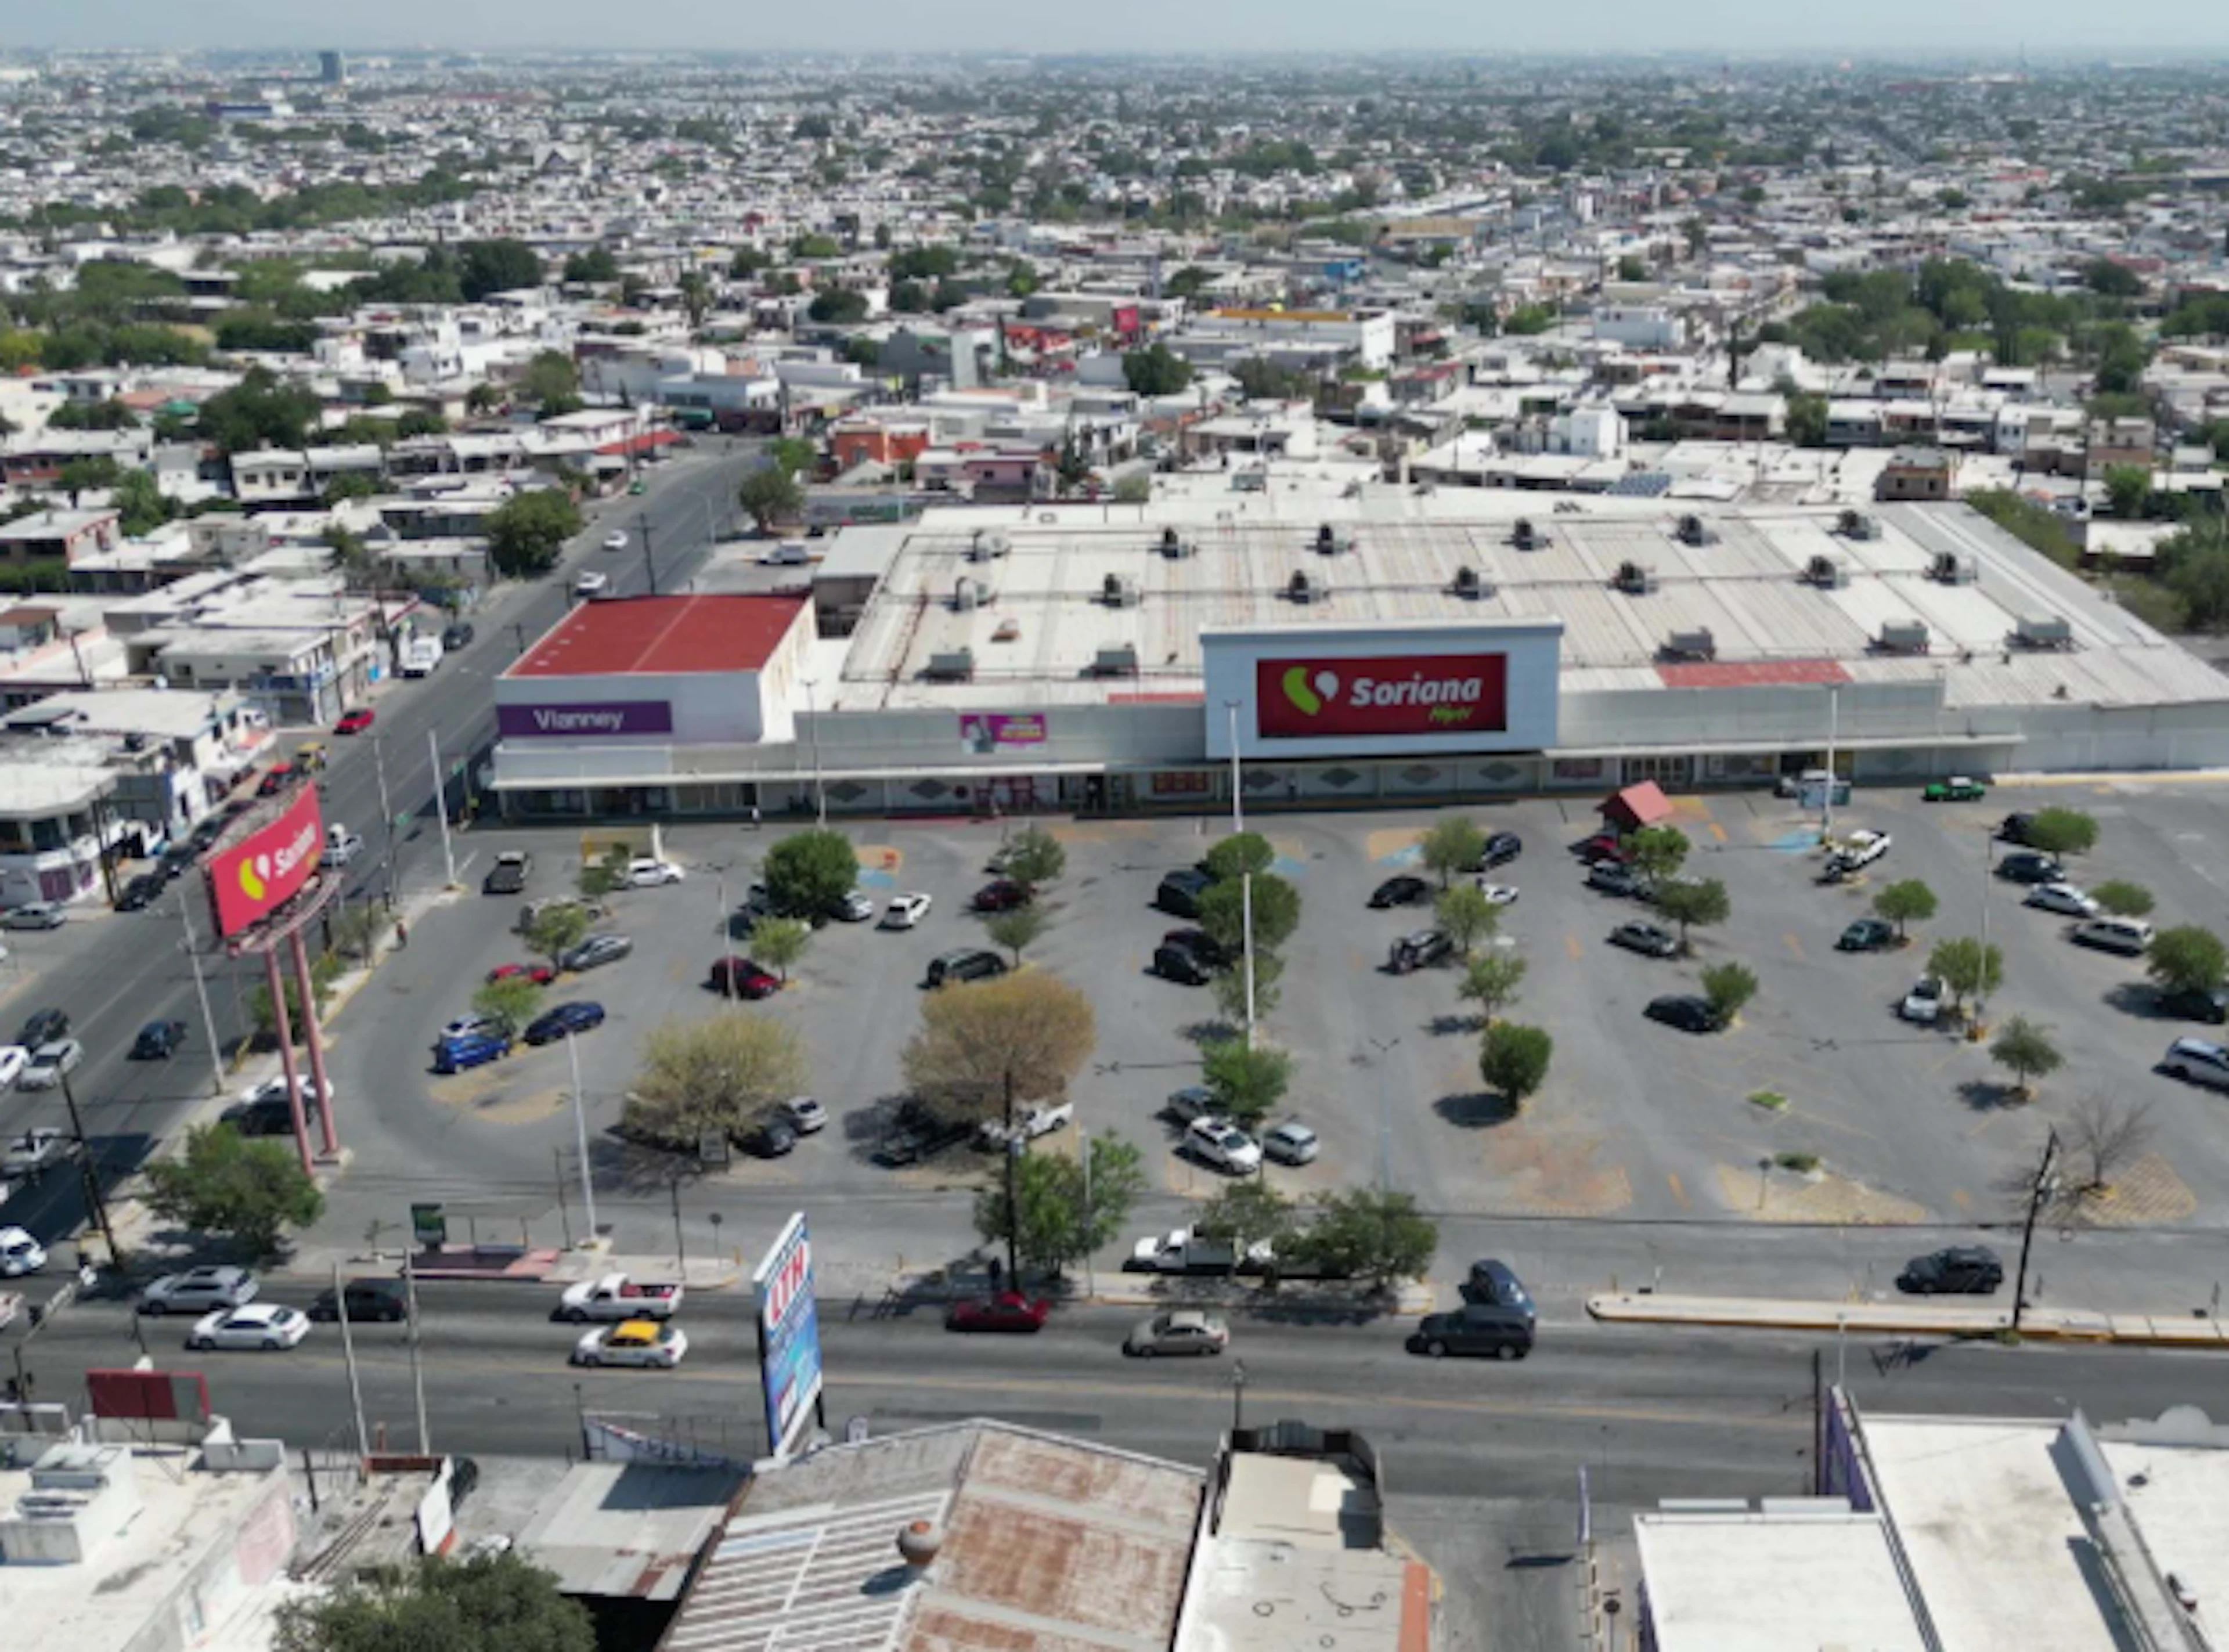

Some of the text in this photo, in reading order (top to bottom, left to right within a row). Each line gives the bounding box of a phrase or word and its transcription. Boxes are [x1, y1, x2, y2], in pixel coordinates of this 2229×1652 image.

[1350, 671, 1483, 706] Soriana
[533, 709, 624, 731] Vianney
[770, 1243, 804, 1323] LTH
